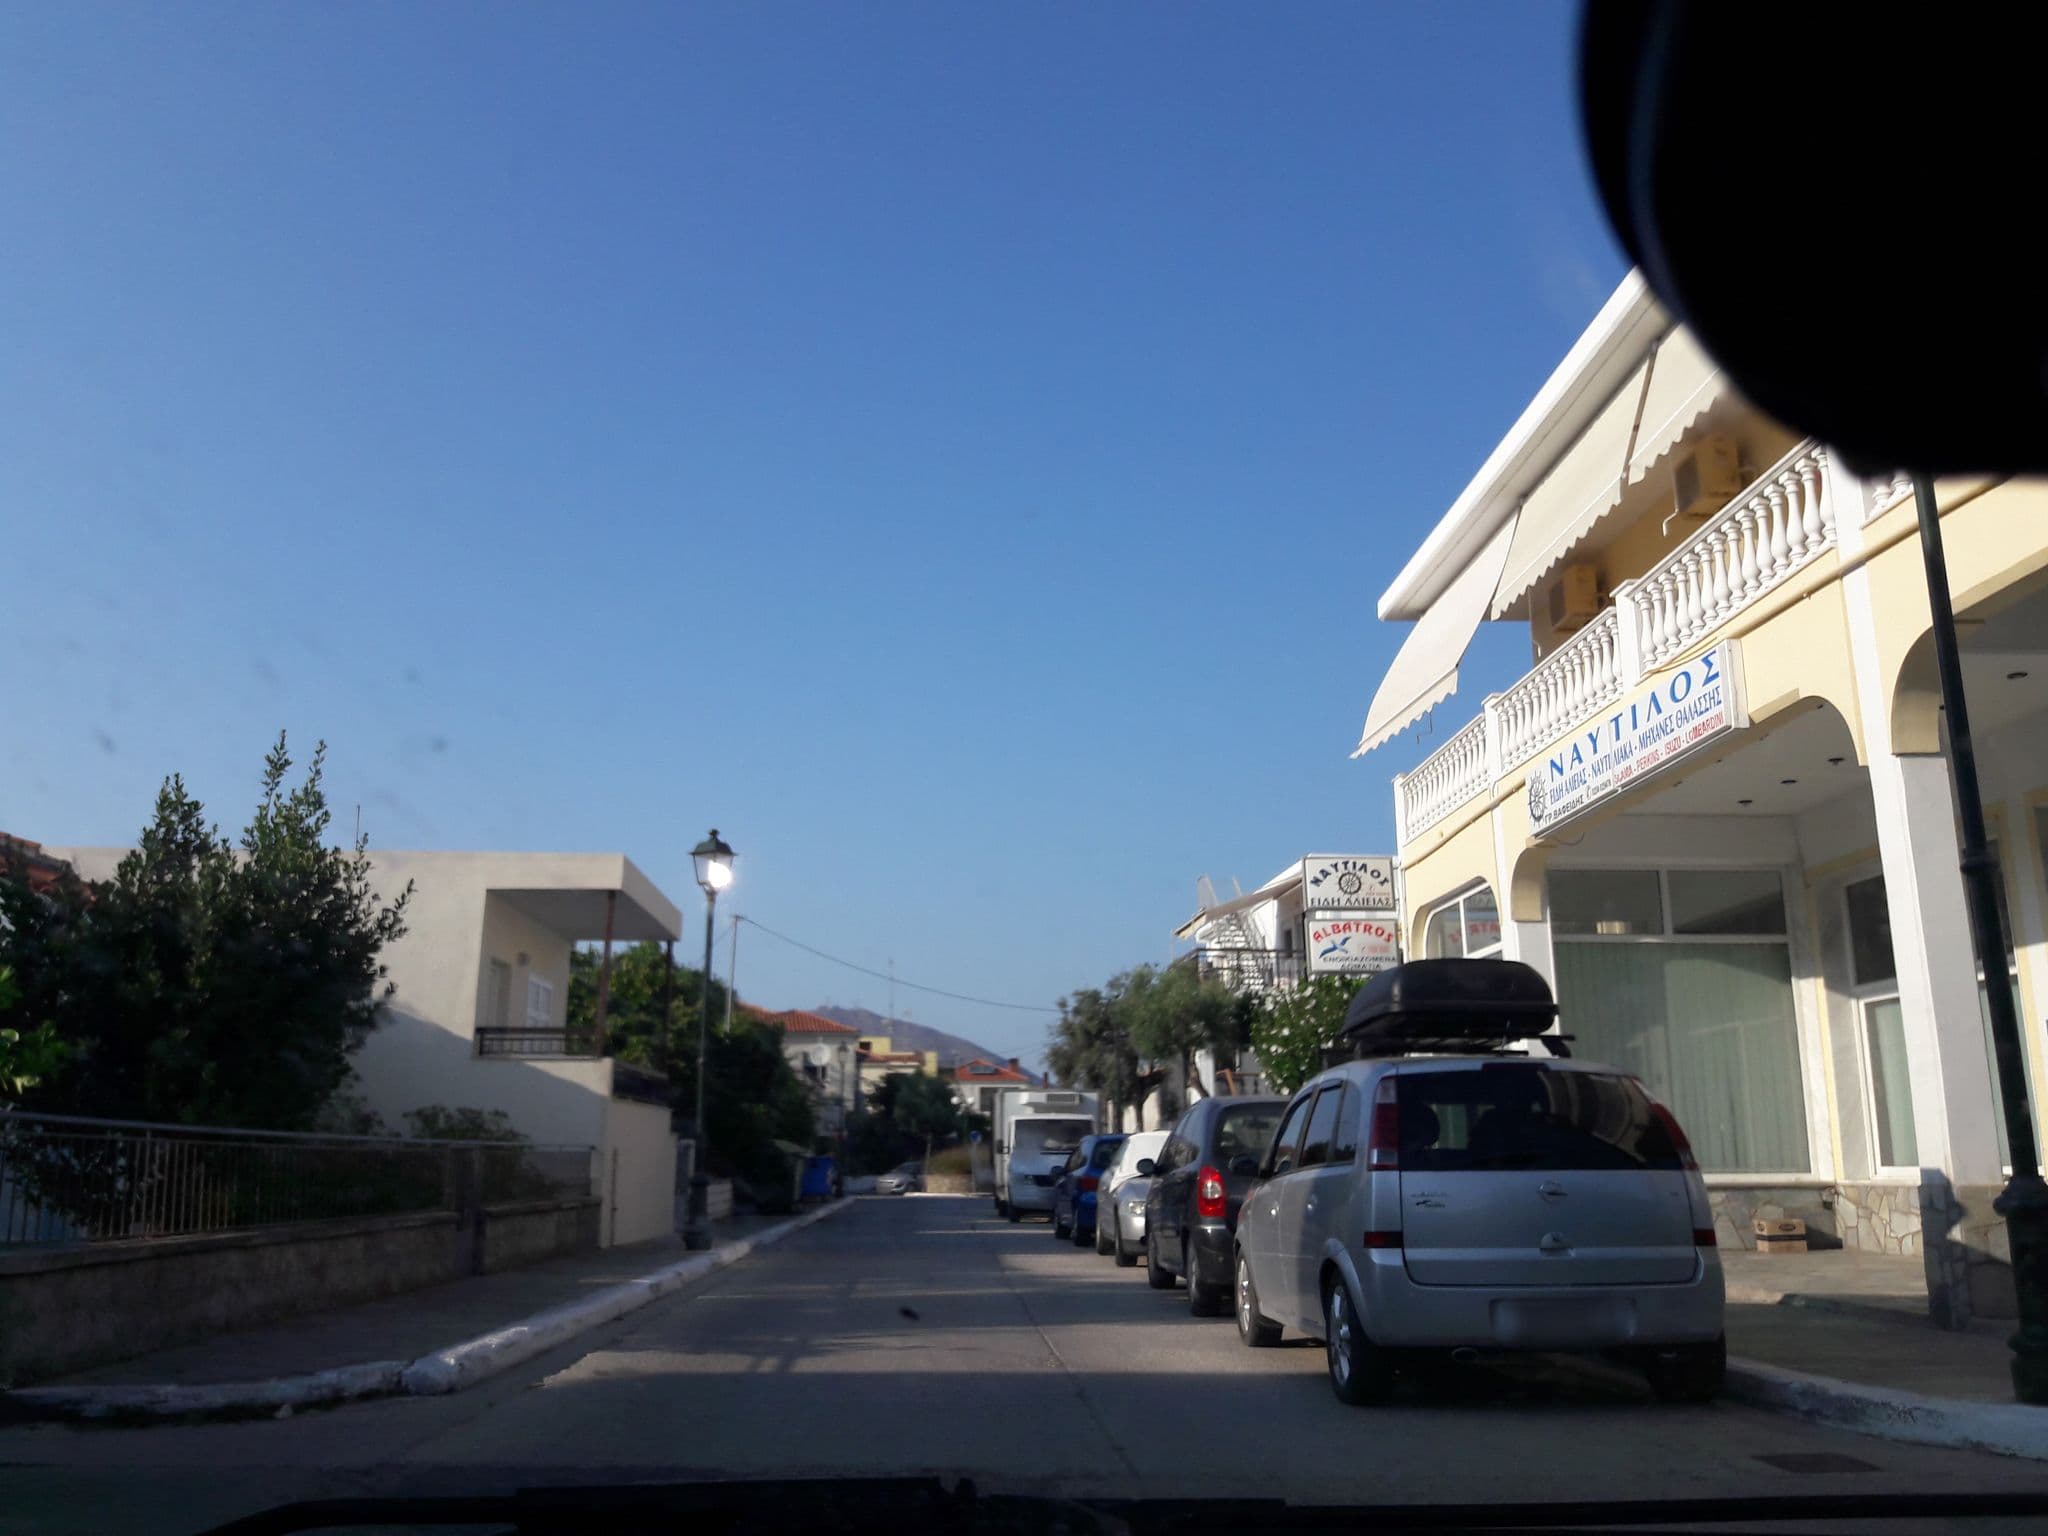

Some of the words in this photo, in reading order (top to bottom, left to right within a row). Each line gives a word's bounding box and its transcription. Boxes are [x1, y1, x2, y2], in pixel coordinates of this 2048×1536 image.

[1549, 650, 1720, 783] ΝΑΥΤΙΛΟΣ
[1549, 781, 1564, 805] ΕΙΔΗ
[1639, 714, 1675, 753] ΜΗΧΑΝΕΣ
[1675, 685, 1722, 729] ΘΑΛΑΣΣΗΣ
[1664, 736, 1681, 756] ISUZU
[1310, 861, 1390, 887] ΝΑΥΤΙΛΟΣ
[1311, 897, 1341, 907] ΕΙΔΗ
[1345, 897, 1392, 907] ΑΛΙΕΙΑΣ
[1313, 921, 1394, 944] ALBATROS
